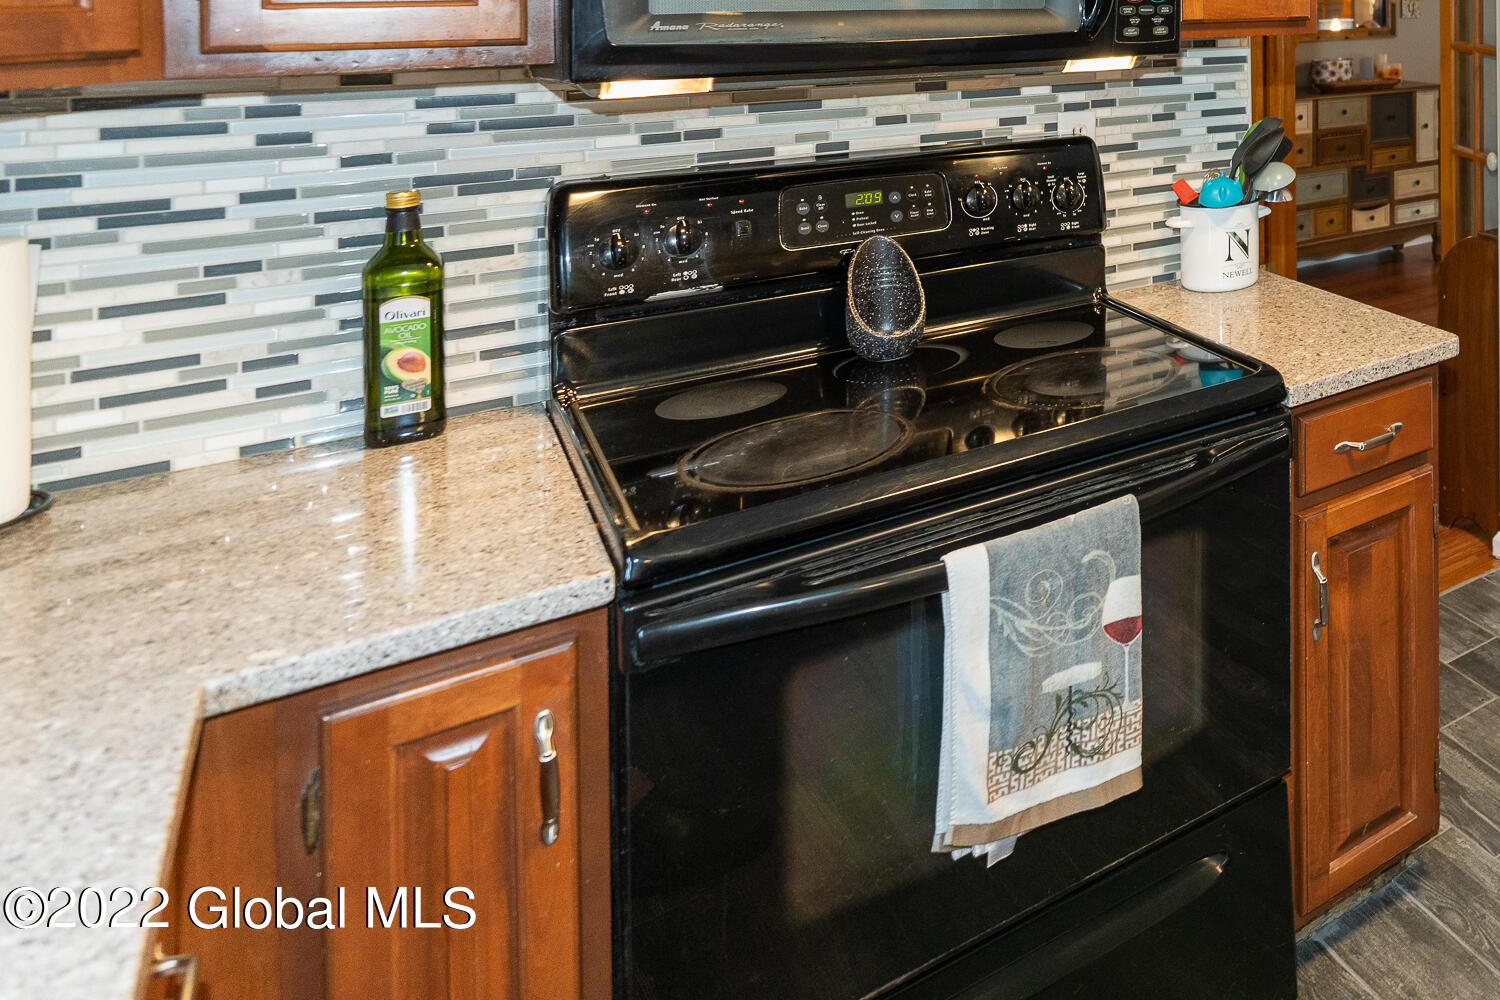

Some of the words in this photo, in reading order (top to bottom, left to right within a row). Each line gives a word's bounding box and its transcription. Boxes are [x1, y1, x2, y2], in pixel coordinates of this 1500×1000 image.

[650, 20, 689, 32] Amana
[855, 191, 882, 205] 2:09
[1225, 229, 1251, 262] N
[1222, 267, 1254, 279] NEWELL
[384, 307, 427, 321] Olivari
[384, 322, 427, 335] AVOCADO
